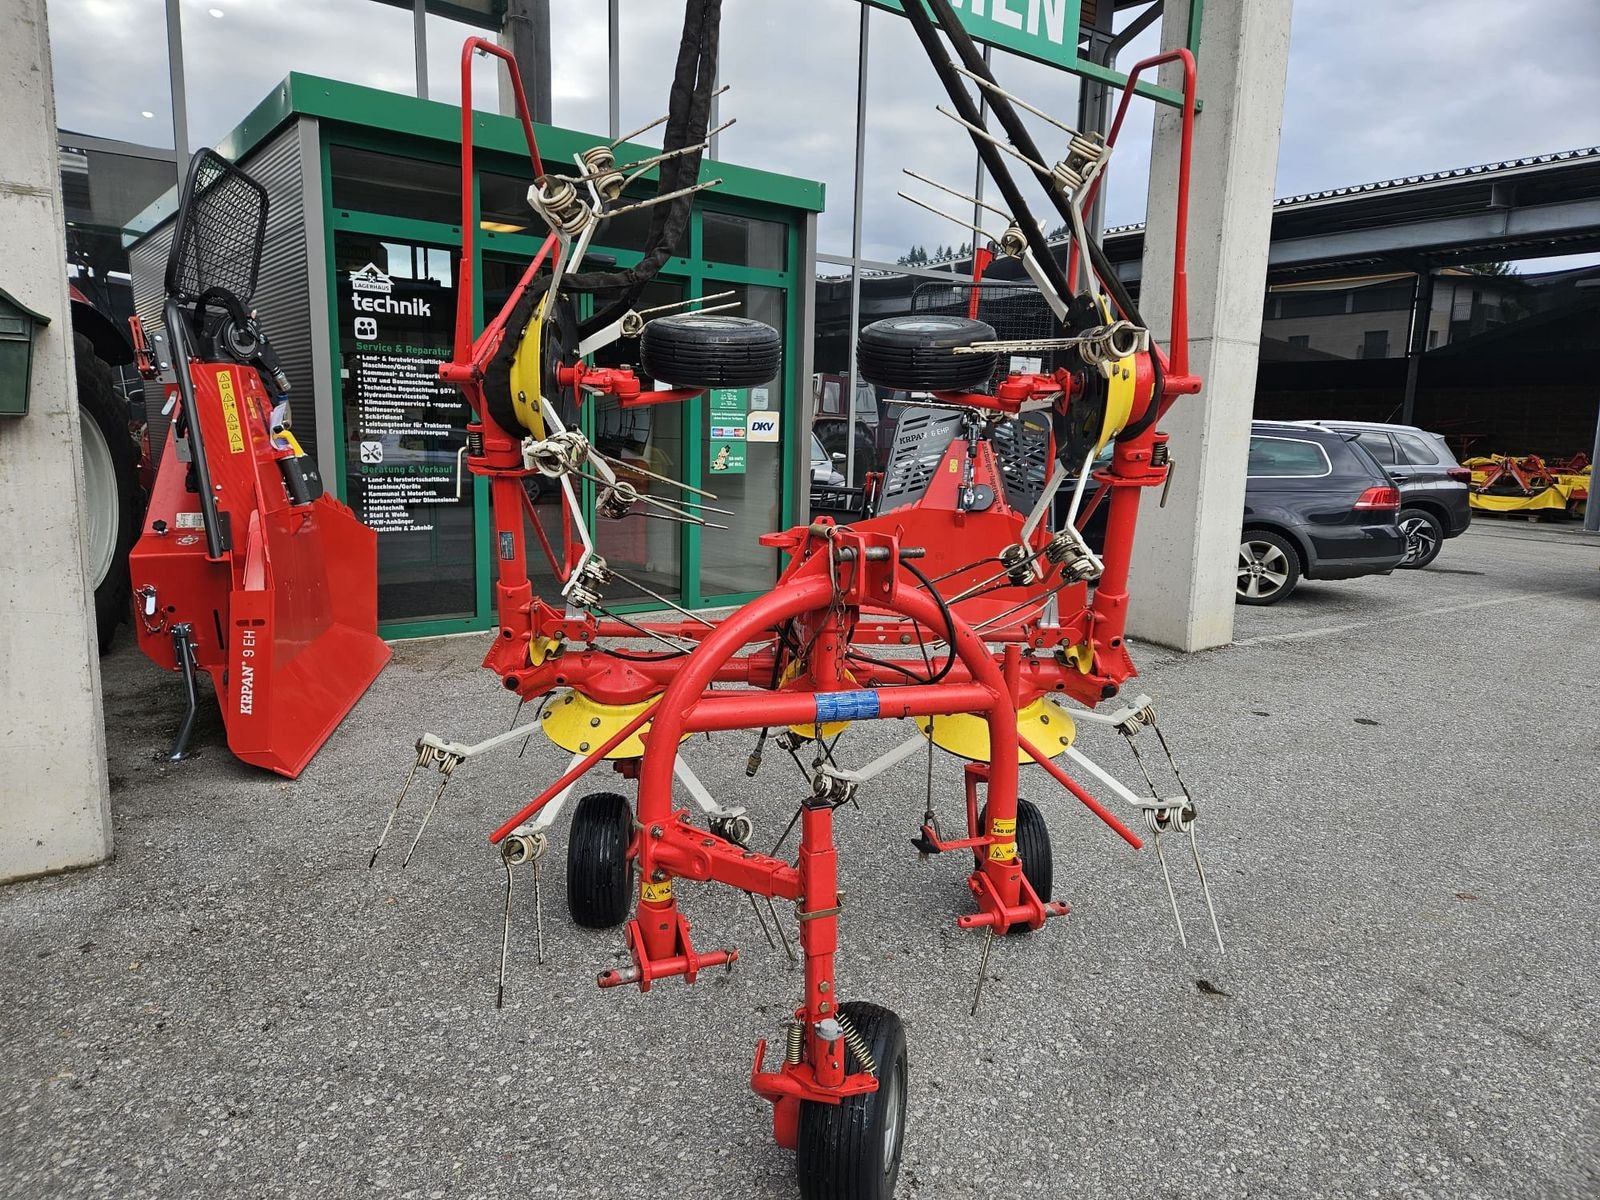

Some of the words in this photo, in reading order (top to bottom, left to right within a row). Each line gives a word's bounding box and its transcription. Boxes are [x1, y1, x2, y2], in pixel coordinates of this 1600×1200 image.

[354, 283, 390, 291] LAGERHAUS
[352, 292, 431, 317] technik
[356, 342, 392, 352] Service
[395, 344, 402, 352] &
[405, 345, 452, 356] Reparatur
[392, 378, 434, 386] Baumaschinen
[398, 386, 438, 394] Begutachtung
[752, 422, 775, 431] DKV
[362, 466, 405, 474] Beratung
[408, 466, 416, 474] &
[418, 465, 452, 473] Verkauf
[242, 630, 256, 646] EH
[242, 649, 254, 658] 9
